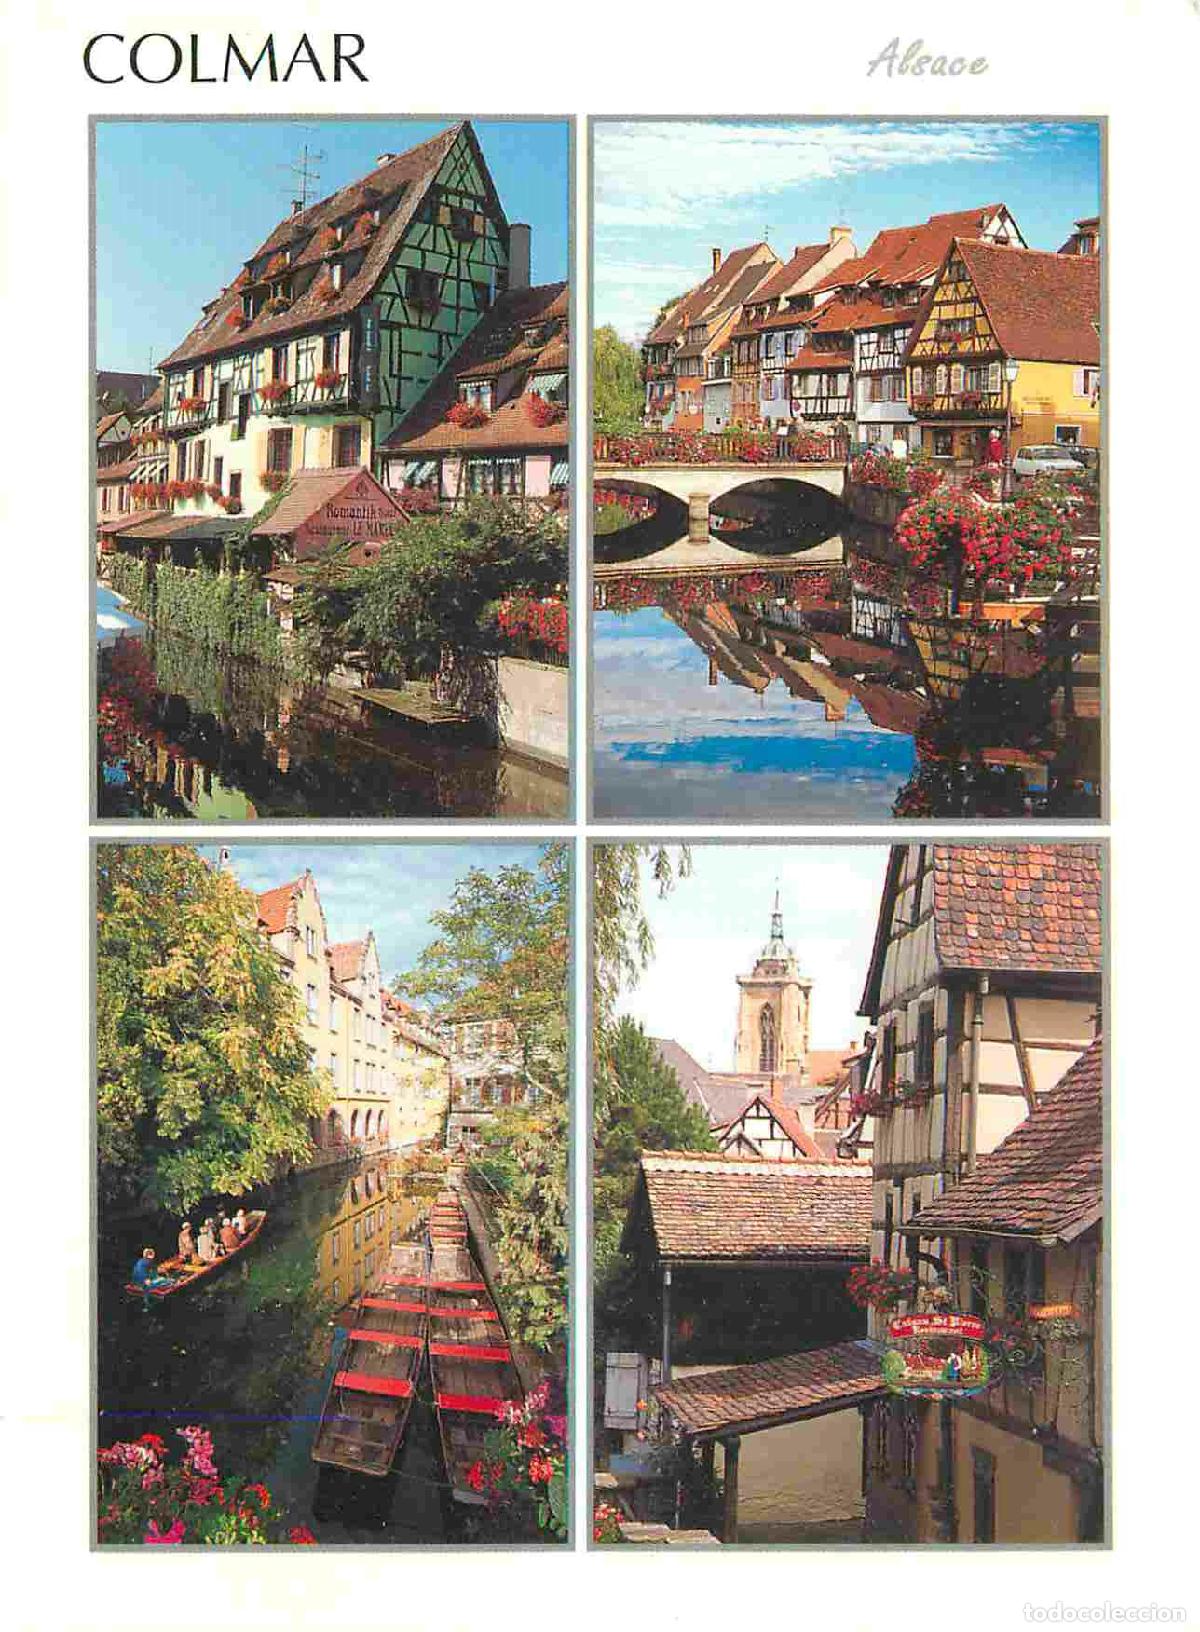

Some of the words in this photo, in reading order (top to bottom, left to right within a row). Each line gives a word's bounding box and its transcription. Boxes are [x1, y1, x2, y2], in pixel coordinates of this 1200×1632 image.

[83, 33, 369, 83] COLMAR
[866, 36, 989, 78] Alsace
[326, 502, 376, 519] Romantik
